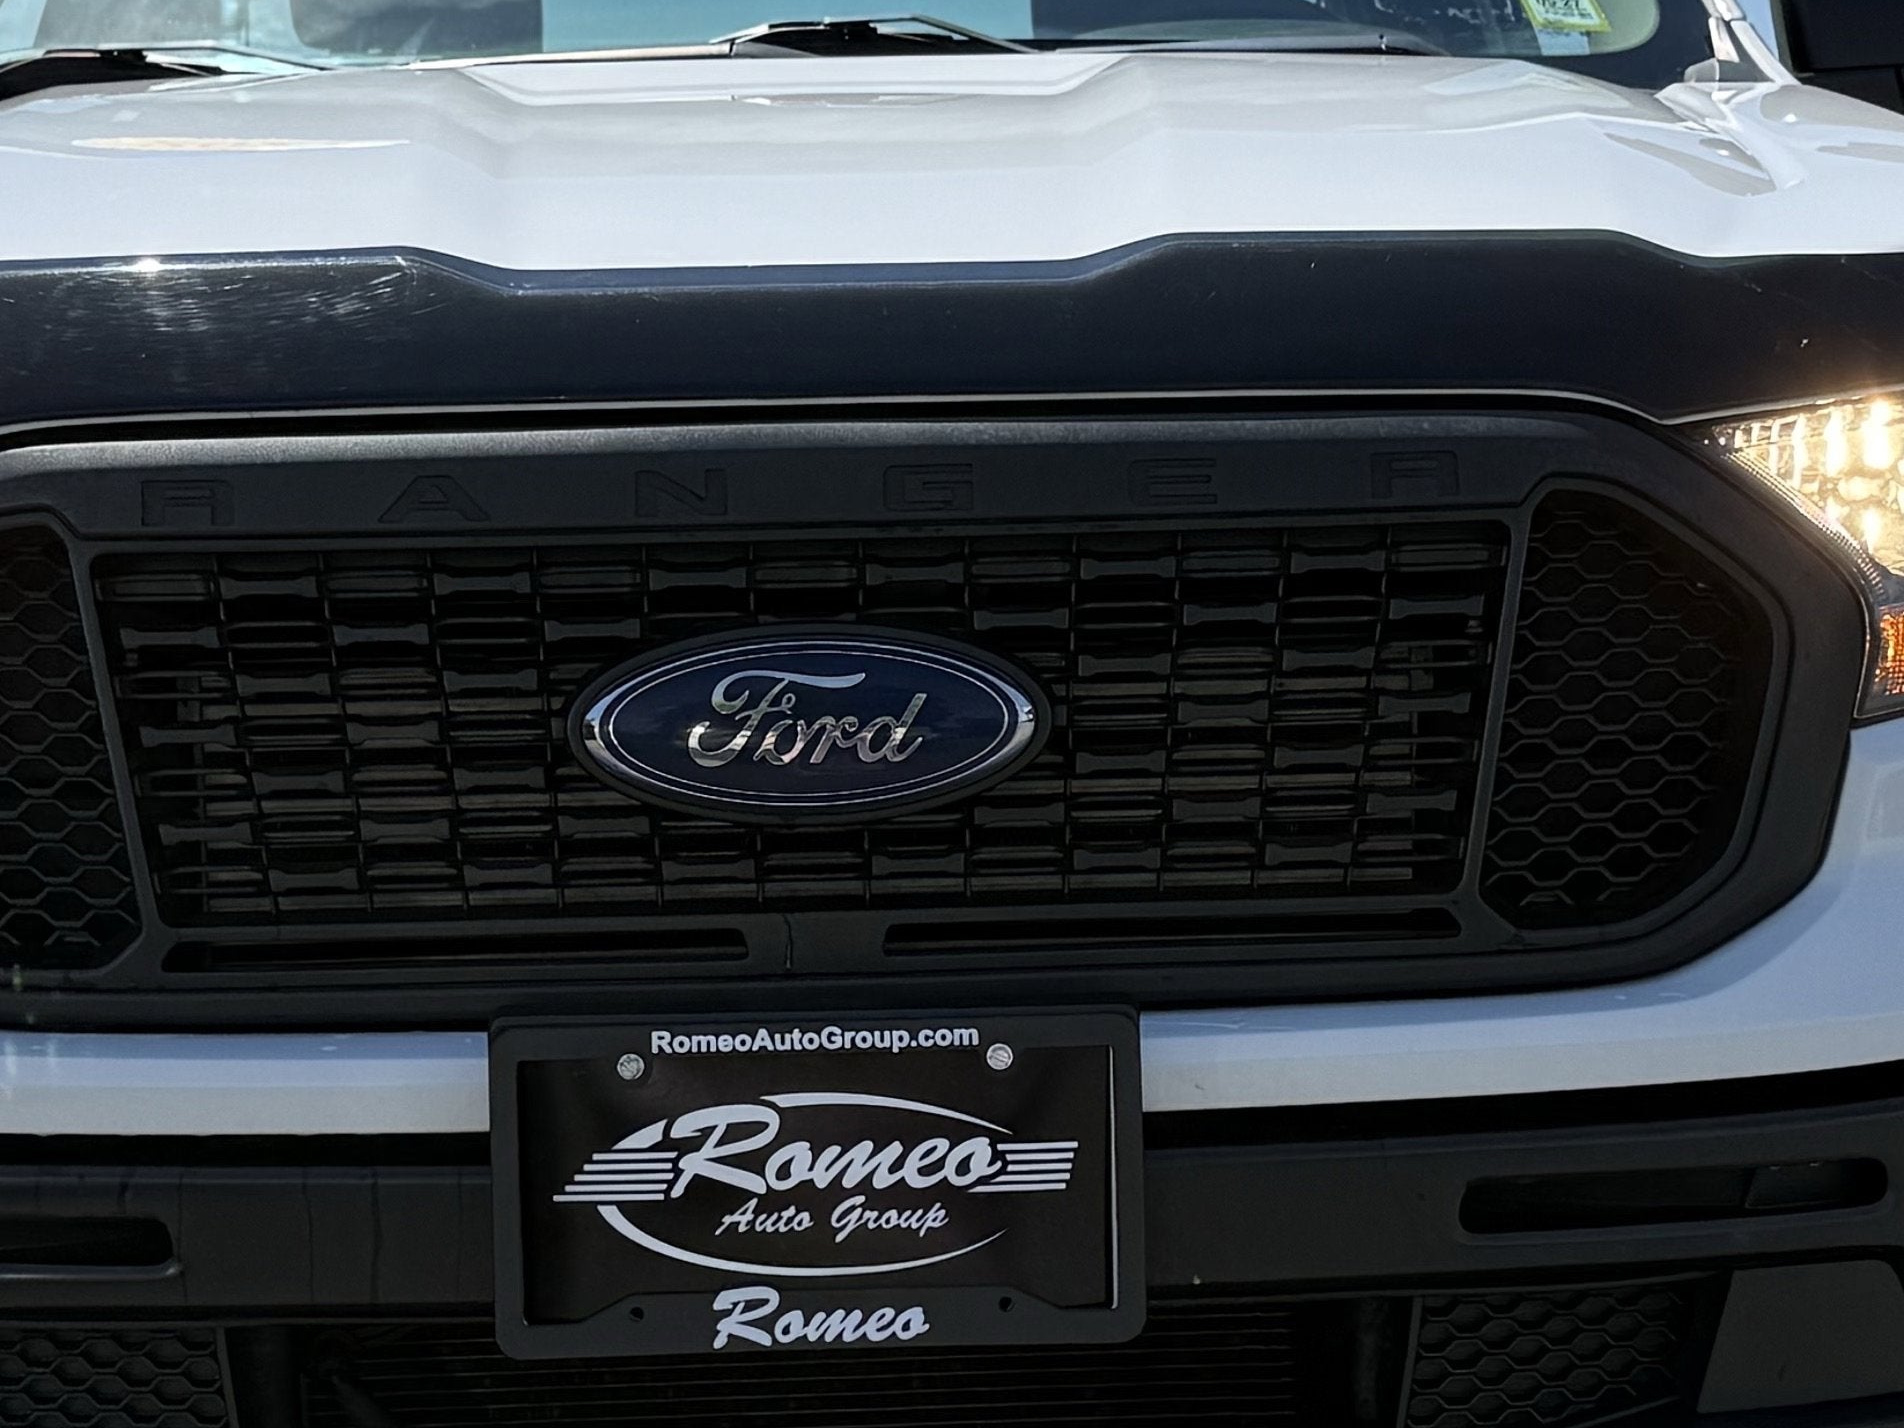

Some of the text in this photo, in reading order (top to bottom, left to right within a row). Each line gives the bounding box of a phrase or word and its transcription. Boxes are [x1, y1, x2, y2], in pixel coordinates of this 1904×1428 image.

[141, 450, 1460, 526] RANGER
[687, 669, 928, 768] Ford
[650, 1025, 980, 1055] RomeoAutoGroup.com
[669, 1103, 1002, 1199] Romeo
[714, 1194, 950, 1243] Auto Group
[711, 1284, 931, 1350] Romeo
